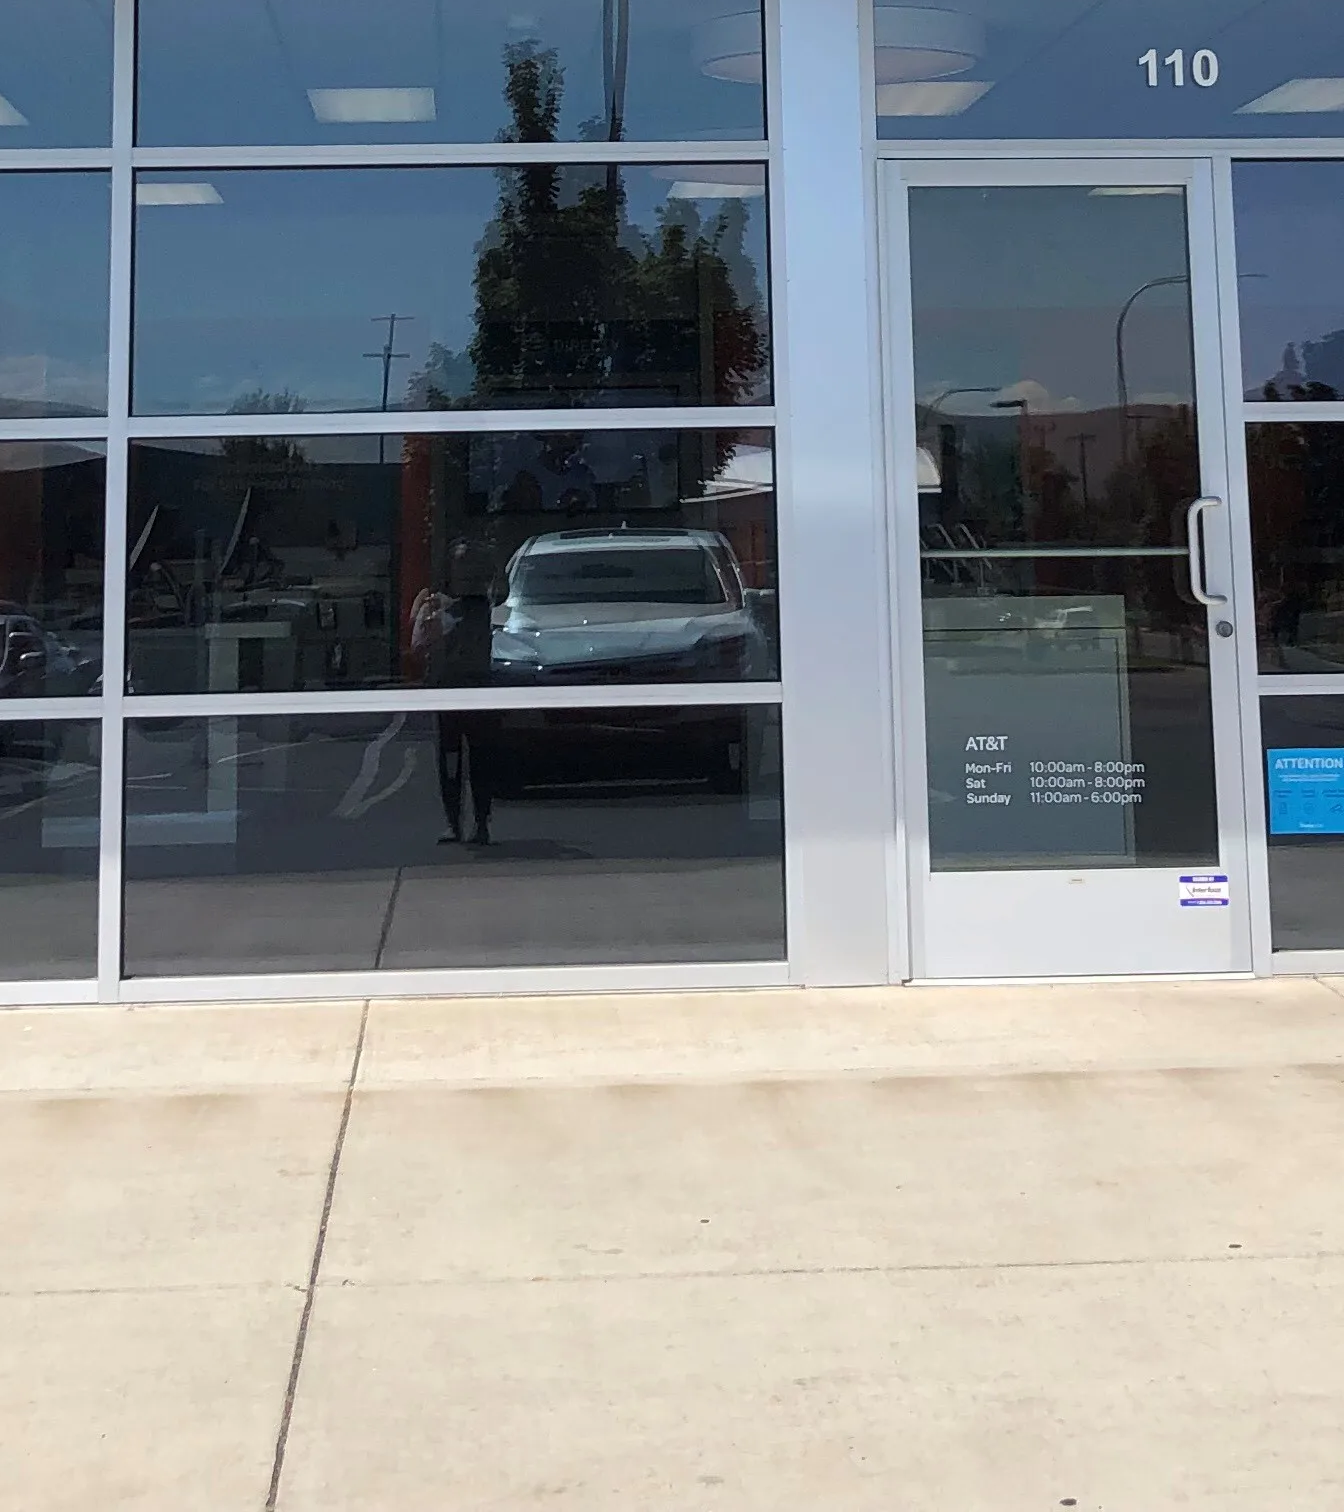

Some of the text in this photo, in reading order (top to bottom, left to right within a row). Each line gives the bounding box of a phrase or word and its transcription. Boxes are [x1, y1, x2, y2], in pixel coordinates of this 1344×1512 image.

[1138, 48, 1219, 87] 110
[965, 735, 1008, 751] AT&T
[965, 762, 1012, 774] Mon-Fri
[1029, 761, 1085, 773] 10:00am
[1094, 761, 1145, 776] 8:00pm
[1275, 757, 1344, 769] ATTENTION
[965, 777, 986, 789] Sat
[1030, 776, 1086, 788] 10:00am
[1094, 776, 1146, 791] 8:00pm
[966, 792, 1011, 805] Sunday
[1030, 792, 1082, 803] 11:00am
[1090, 791, 1142, 806] 6:00pm
